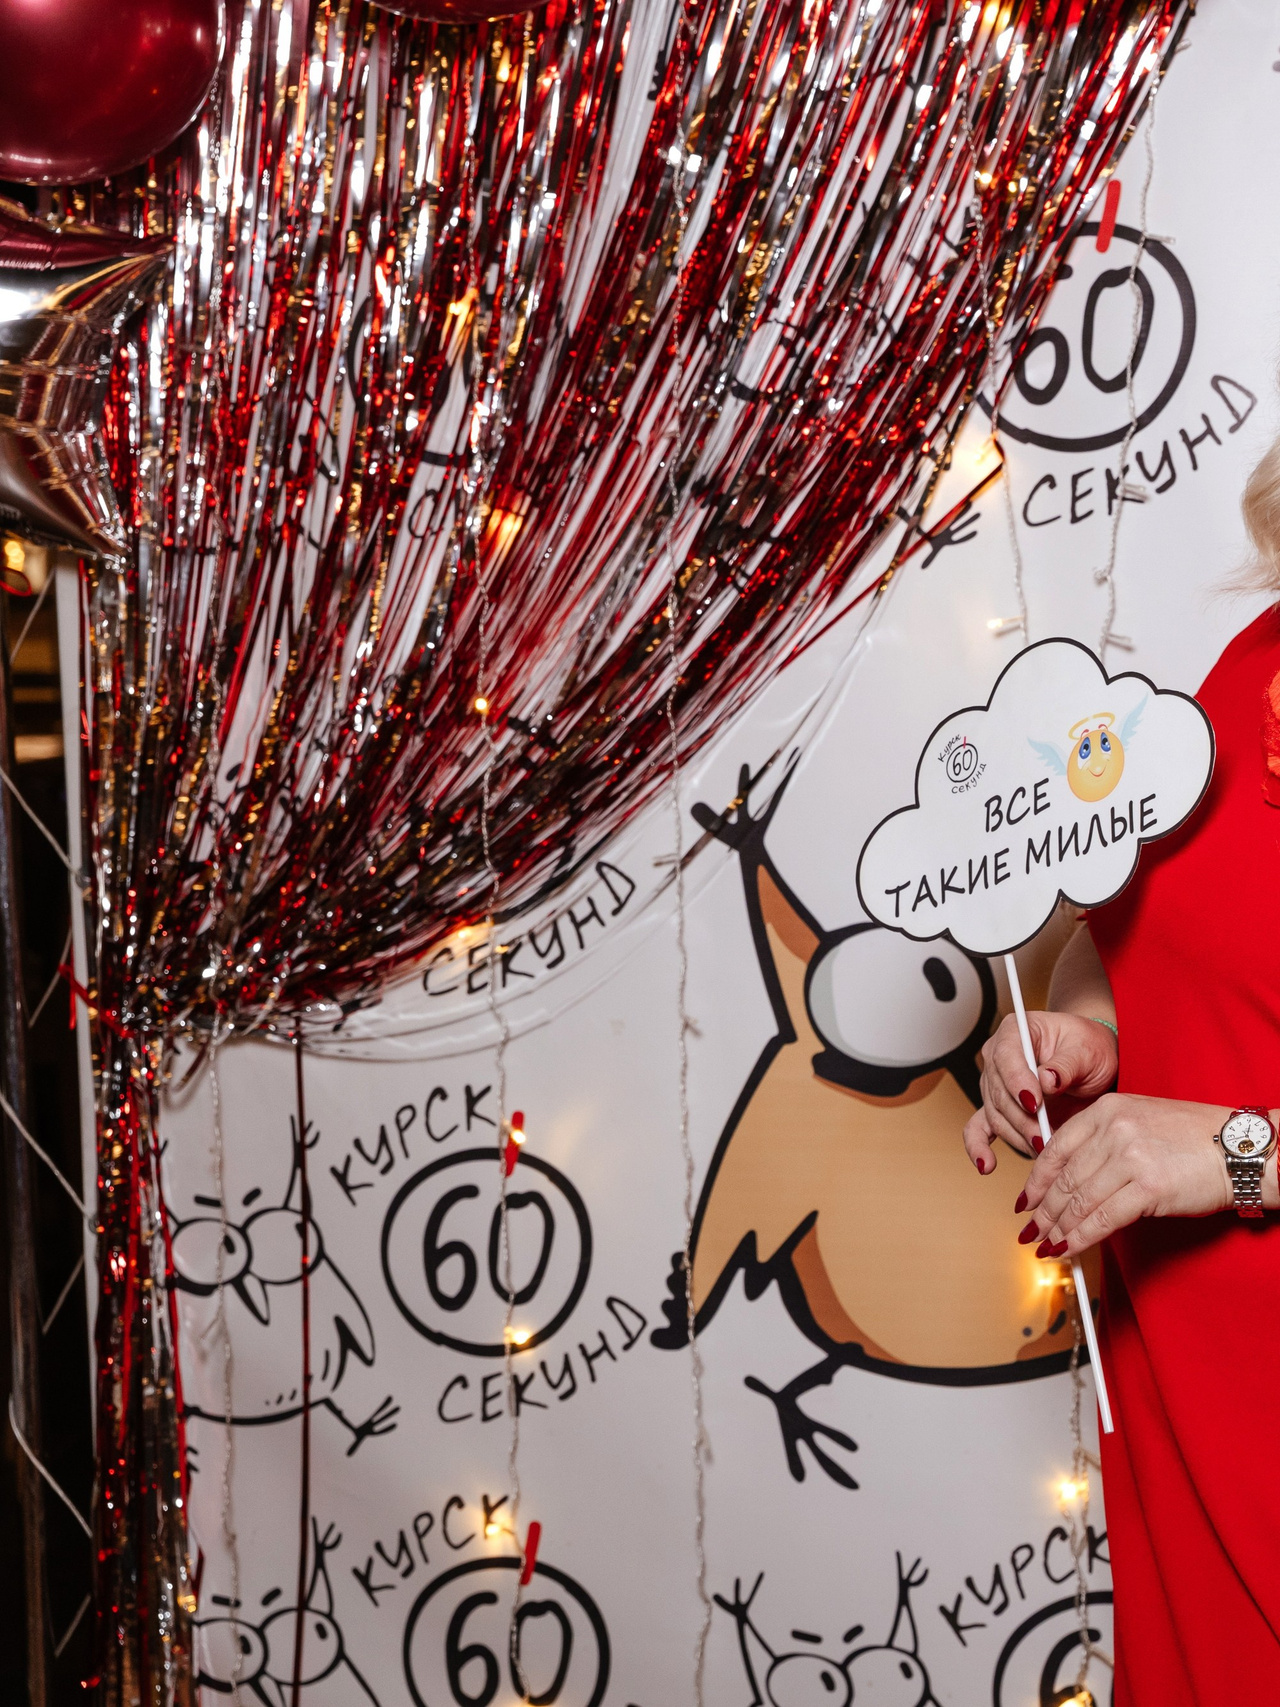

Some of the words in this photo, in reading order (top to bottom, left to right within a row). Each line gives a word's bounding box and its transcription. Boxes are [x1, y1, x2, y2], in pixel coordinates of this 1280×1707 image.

[1011, 264, 1155, 406] 60
[1022, 374, 1258, 527] СЕКУНД
[952, 748, 973, 777] 60
[984, 777, 1051, 833] ВСЕ
[884, 847, 1011, 918] ТАКИЕ
[1025, 793, 1158, 874] МИЛЫЕ
[330, 1084, 497, 1208] КУРСК
[423, 1184, 555, 1313] 60
[438, 1296, 648, 1424] СЕКУНД
[352, 1494, 509, 1609] КУРСК
[938, 1525, 1112, 1648] КУРСК
[445, 1591, 573, 1707] 60
